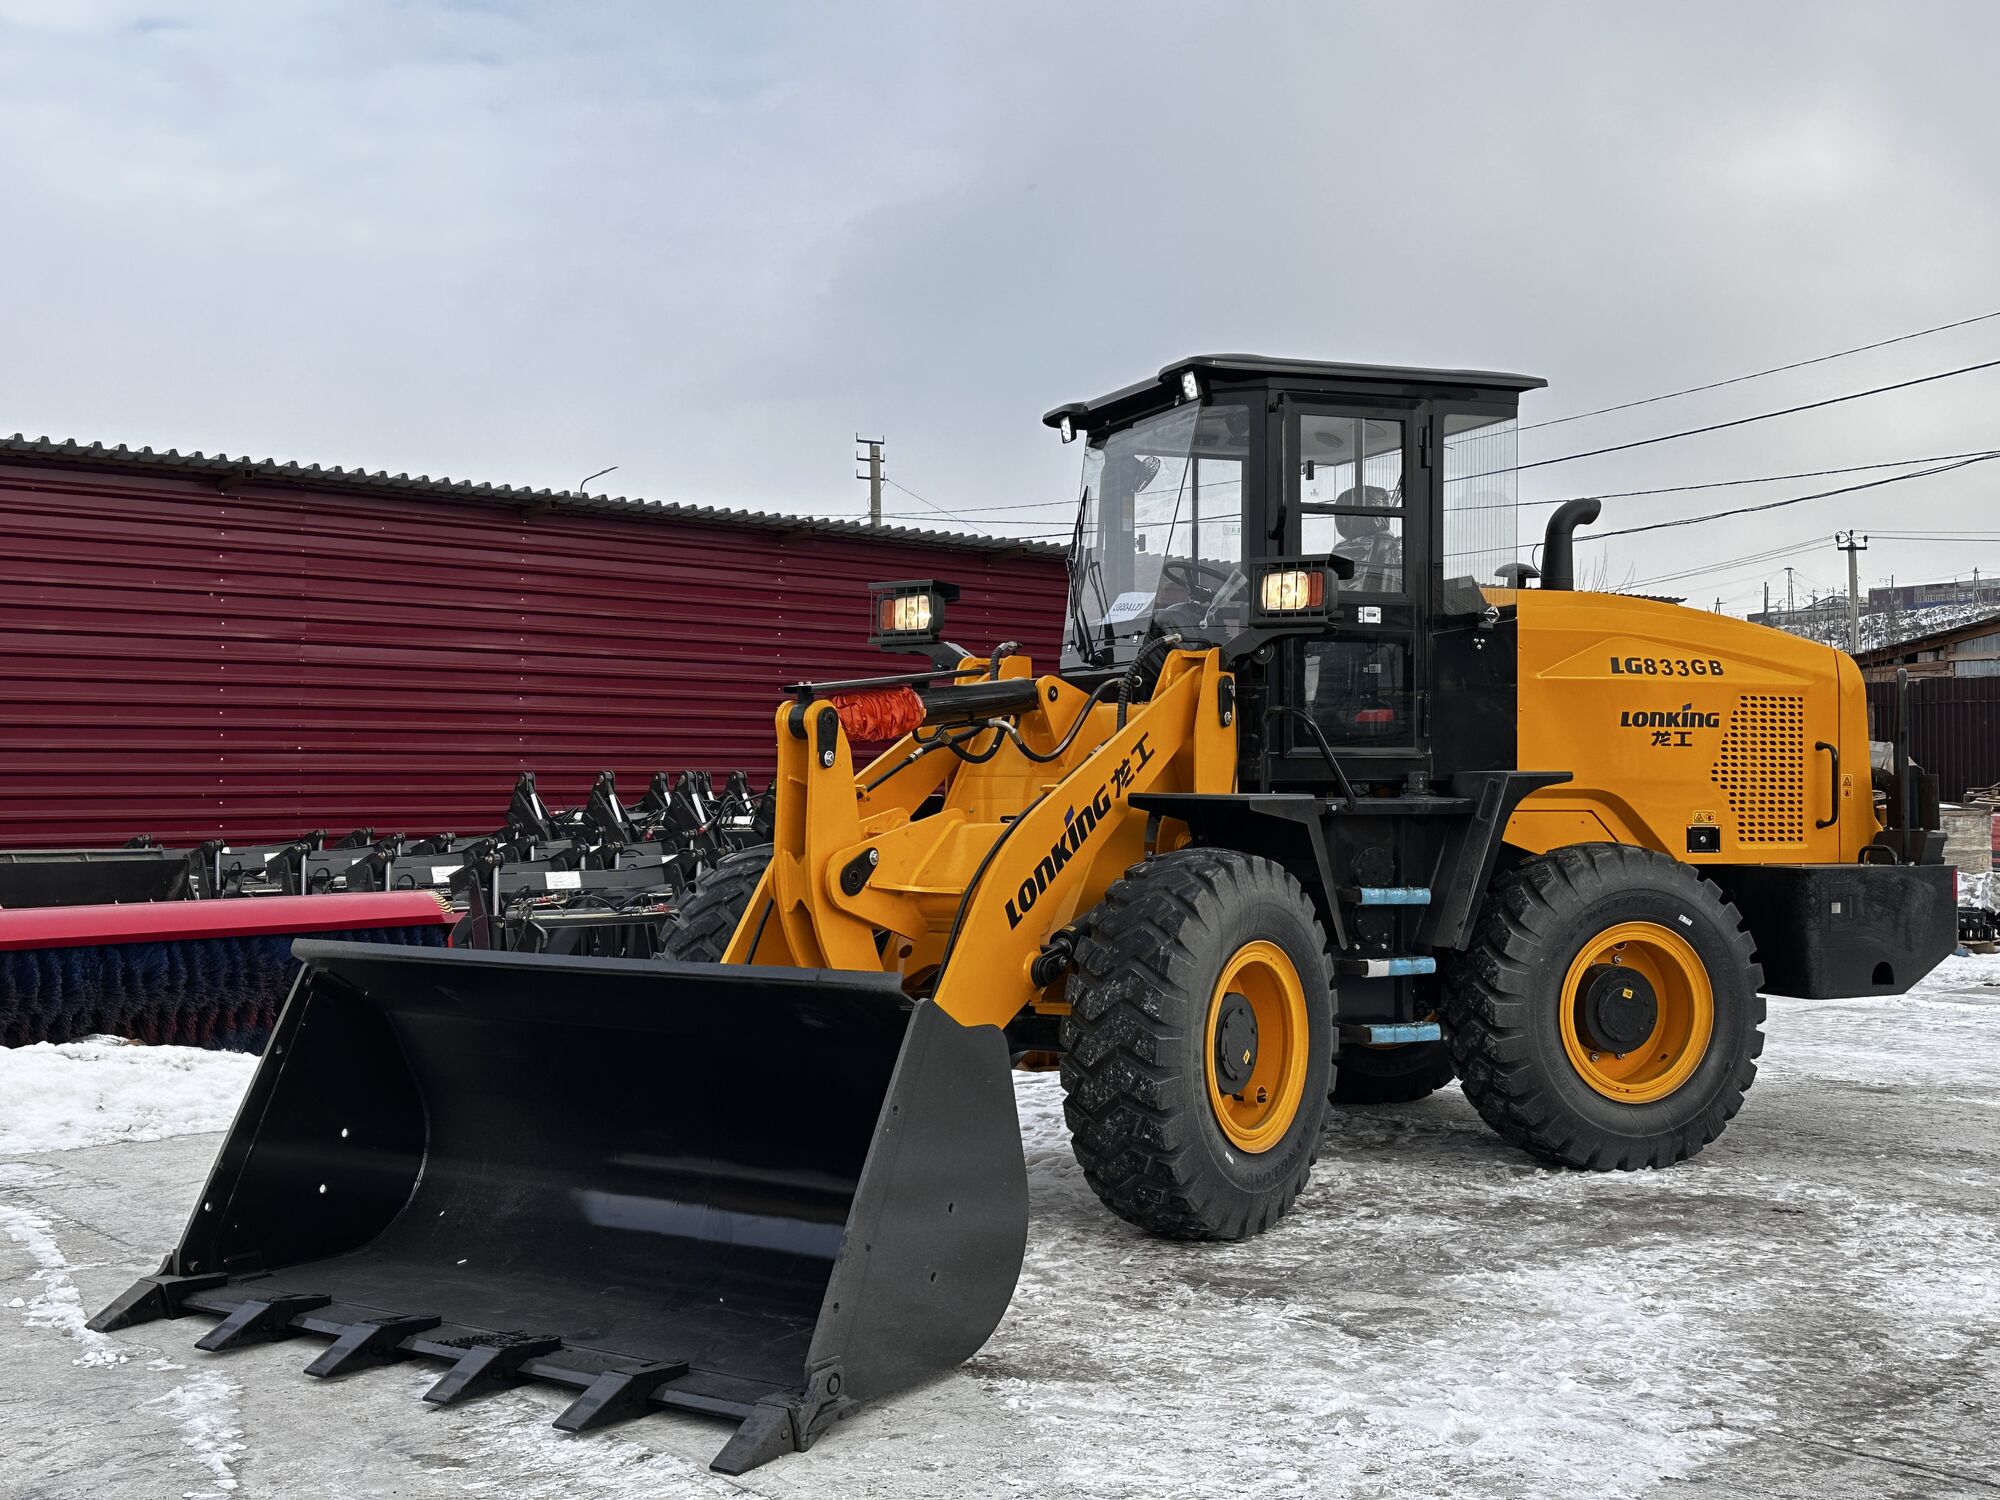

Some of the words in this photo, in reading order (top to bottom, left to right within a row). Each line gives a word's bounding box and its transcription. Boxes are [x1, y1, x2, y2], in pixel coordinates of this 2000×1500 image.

[1610, 657, 1724, 676] LG833GB
[1620, 703, 1720, 728] LONKING
[1651, 730, 1693, 747] 龙工
[1004, 784, 1112, 930] LONKING
[1110, 731, 1155, 798] 龙工
